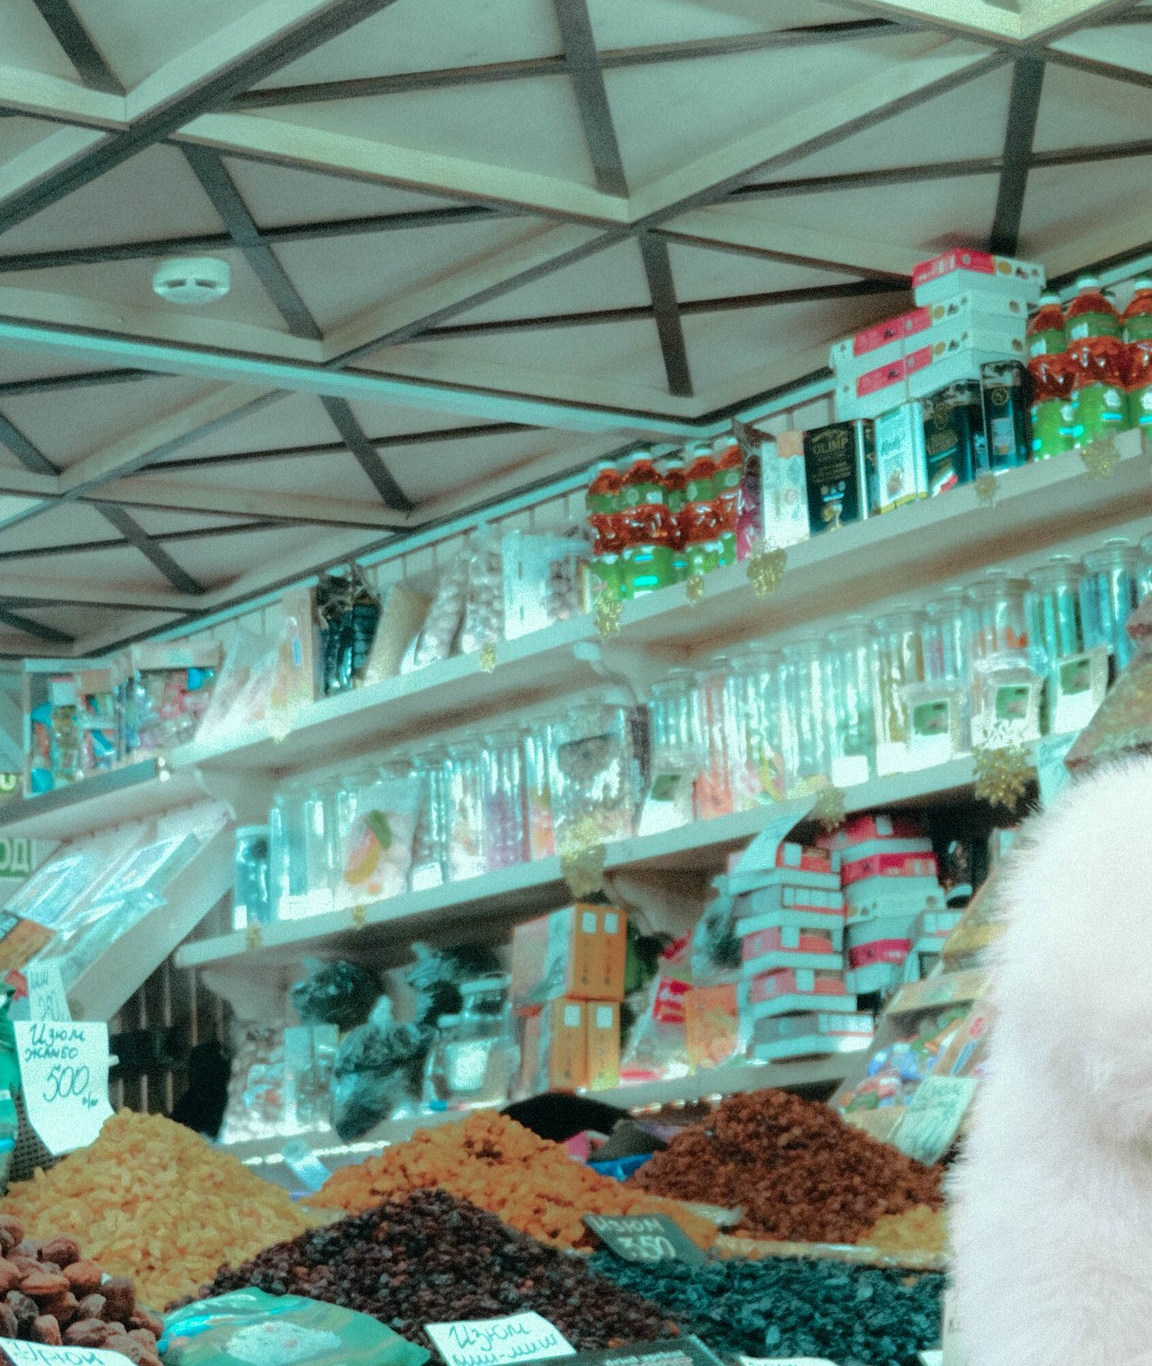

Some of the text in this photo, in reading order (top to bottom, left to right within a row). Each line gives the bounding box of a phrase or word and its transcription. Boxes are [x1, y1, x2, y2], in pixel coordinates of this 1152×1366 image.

[29, 1023, 85, 1046] Изюм
[43, 1065, 89, 1102] 500
[448, 1322, 532, 1351] Изюм
